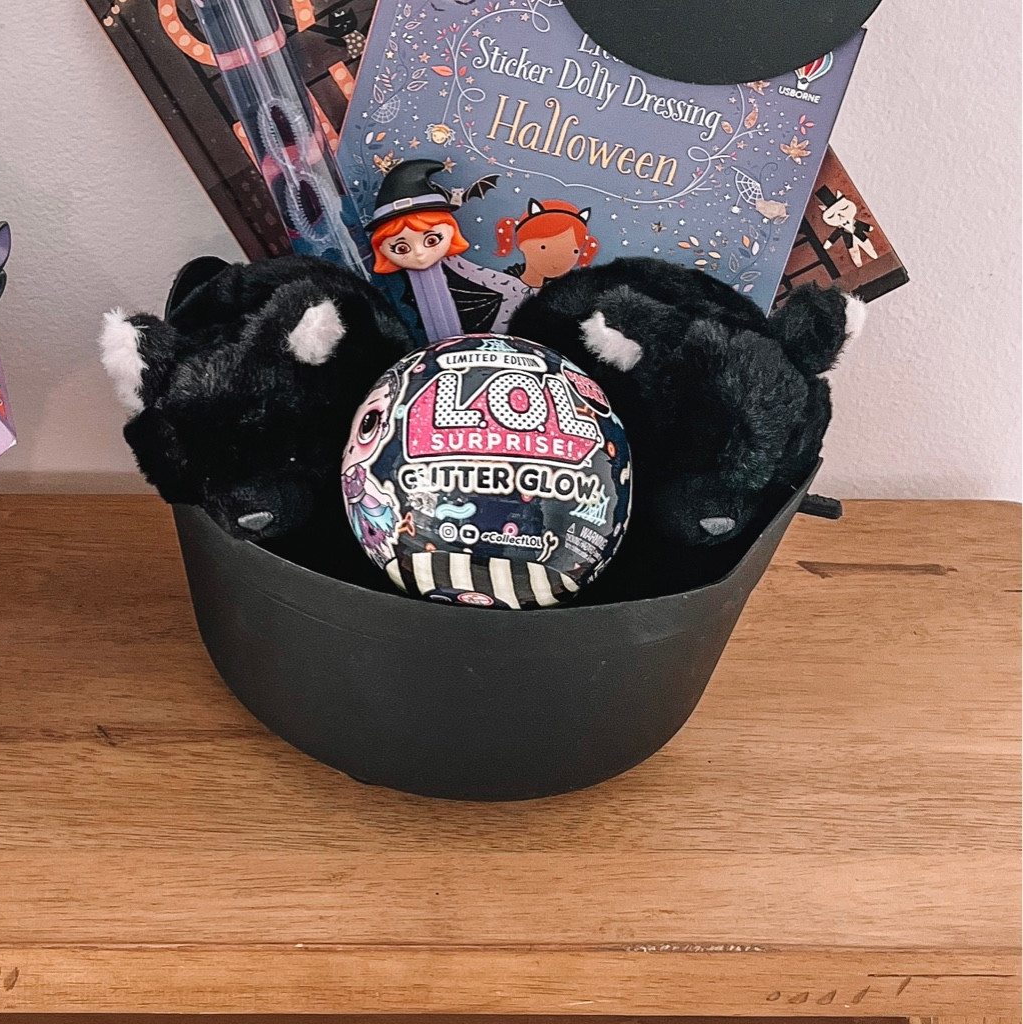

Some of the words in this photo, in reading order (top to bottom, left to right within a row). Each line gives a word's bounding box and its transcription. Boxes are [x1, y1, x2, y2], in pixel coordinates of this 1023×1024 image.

[472, 36, 552, 85] Sticker
[557, 58, 620, 111] Dolly
[622, 75, 722, 141] Dressing
[778, 86, 821, 104] USBORNE
[486, 94, 678, 186] Halloween
[446, 353, 497, 365] LIMITED
[503, 355, 542, 368] EDITION
[430, 432, 574, 458] SURPRISE!
[519, 467, 597, 501] GLOW
[481, 532, 542, 548] #CollectLOL
